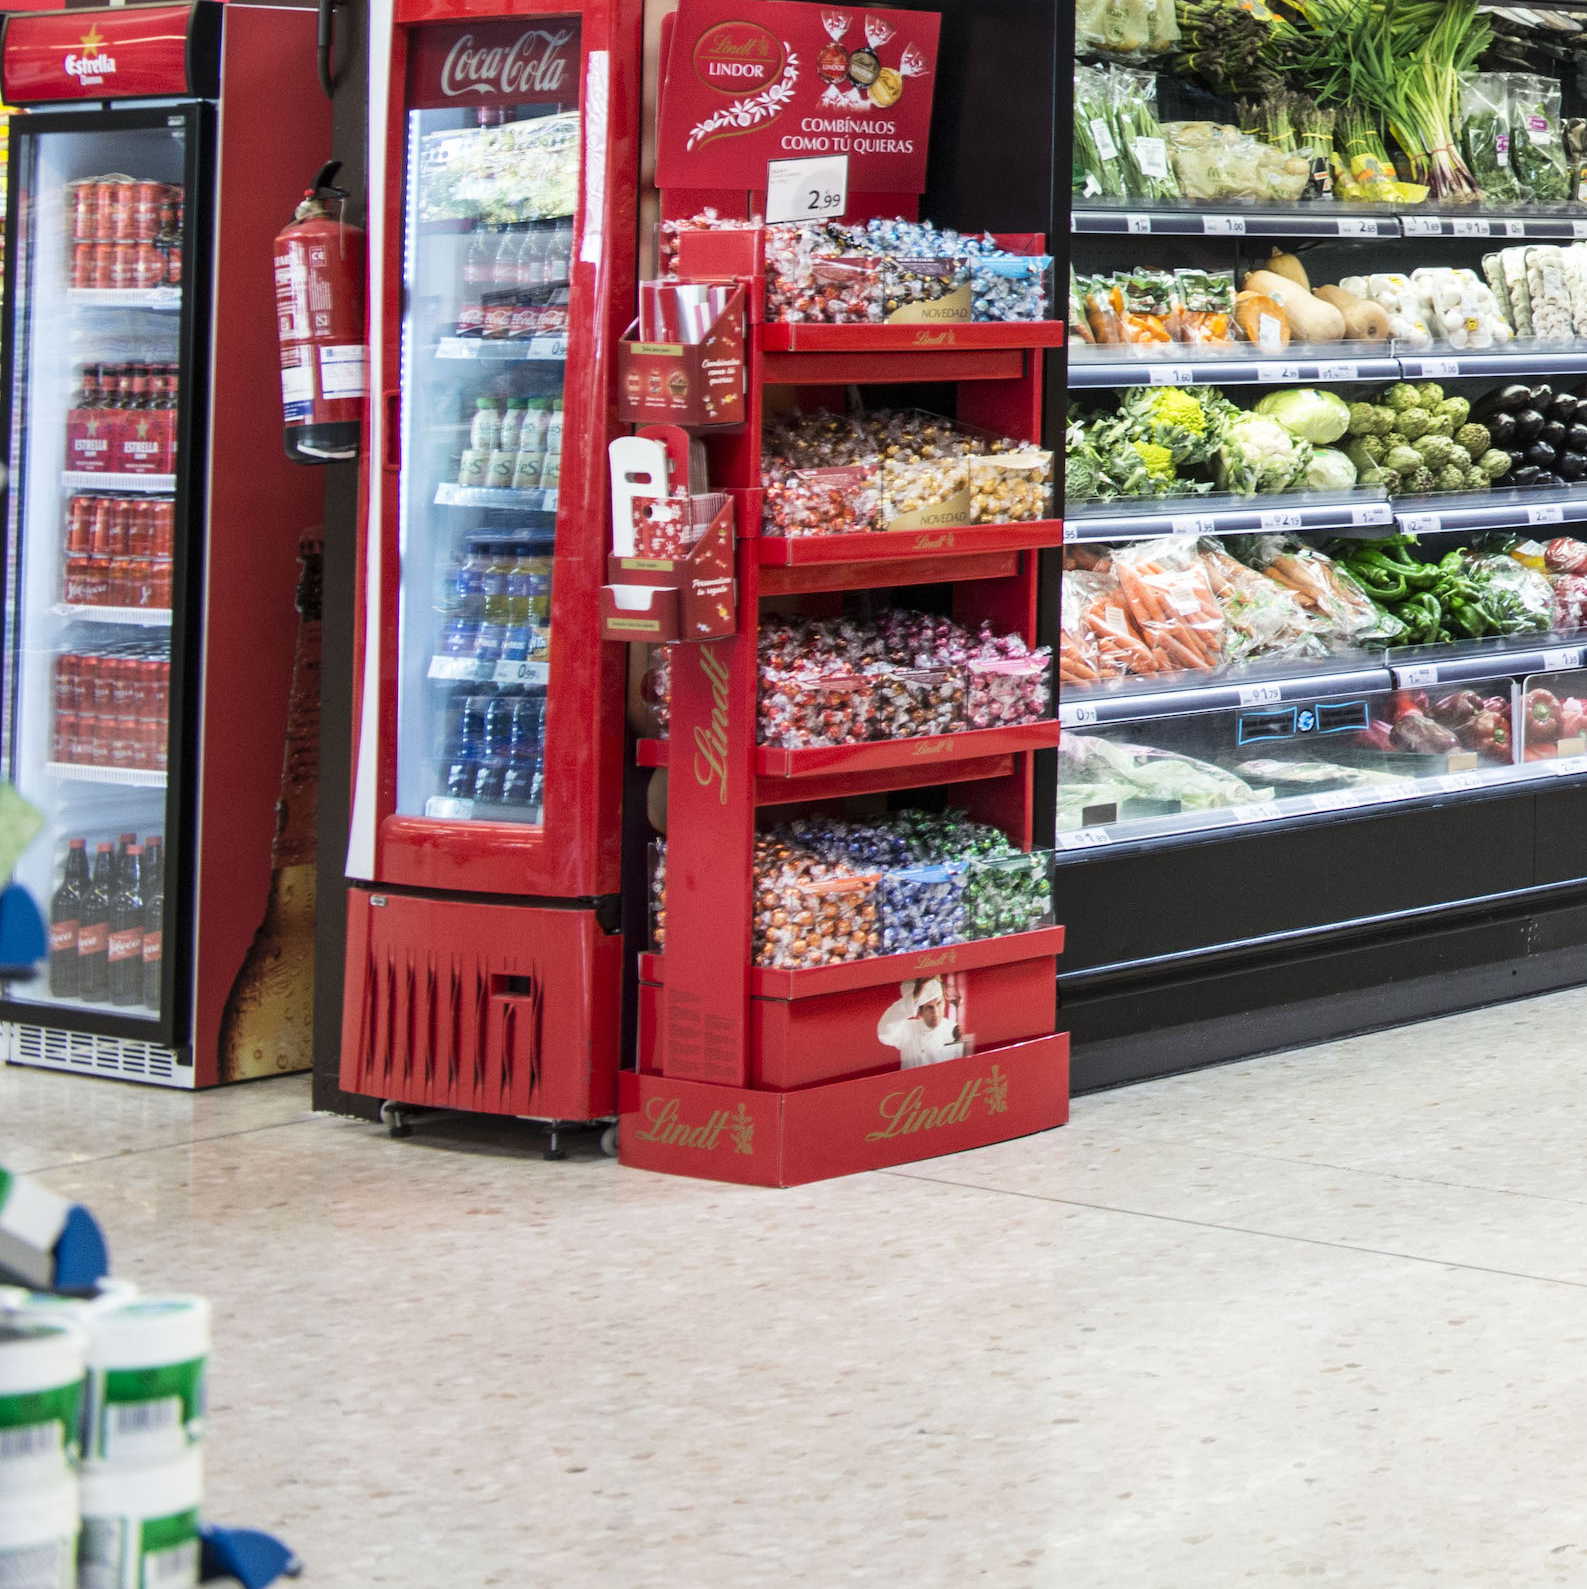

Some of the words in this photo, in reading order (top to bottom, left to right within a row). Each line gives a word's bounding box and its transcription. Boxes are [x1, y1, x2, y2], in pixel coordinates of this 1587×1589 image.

[64, 53, 117, 76] Estrella
[708, 62, 764, 78] LINDOR
[801, 116, 896, 134] COMBÍNALOS
[780, 135, 830, 151] COMO
[832, 134, 850, 151] TÚ
[853, 138, 914, 154] QUIERAS
[807, 189, 842, 211] 2,99
[920, 307, 968, 319] NOVEDAD
[912, 330, 946, 346] Lindt
[74, 439, 108, 451] ESTRELLA
[123, 441, 159, 454] ESTRELLA
[919, 511, 969, 527] NOVEDAD
[912, 534, 946, 551] Lindt
[693, 645, 730, 806] Lindt
[864, 1076, 984, 1143] Lindt
[635, 1096, 730, 1152] Lindt
